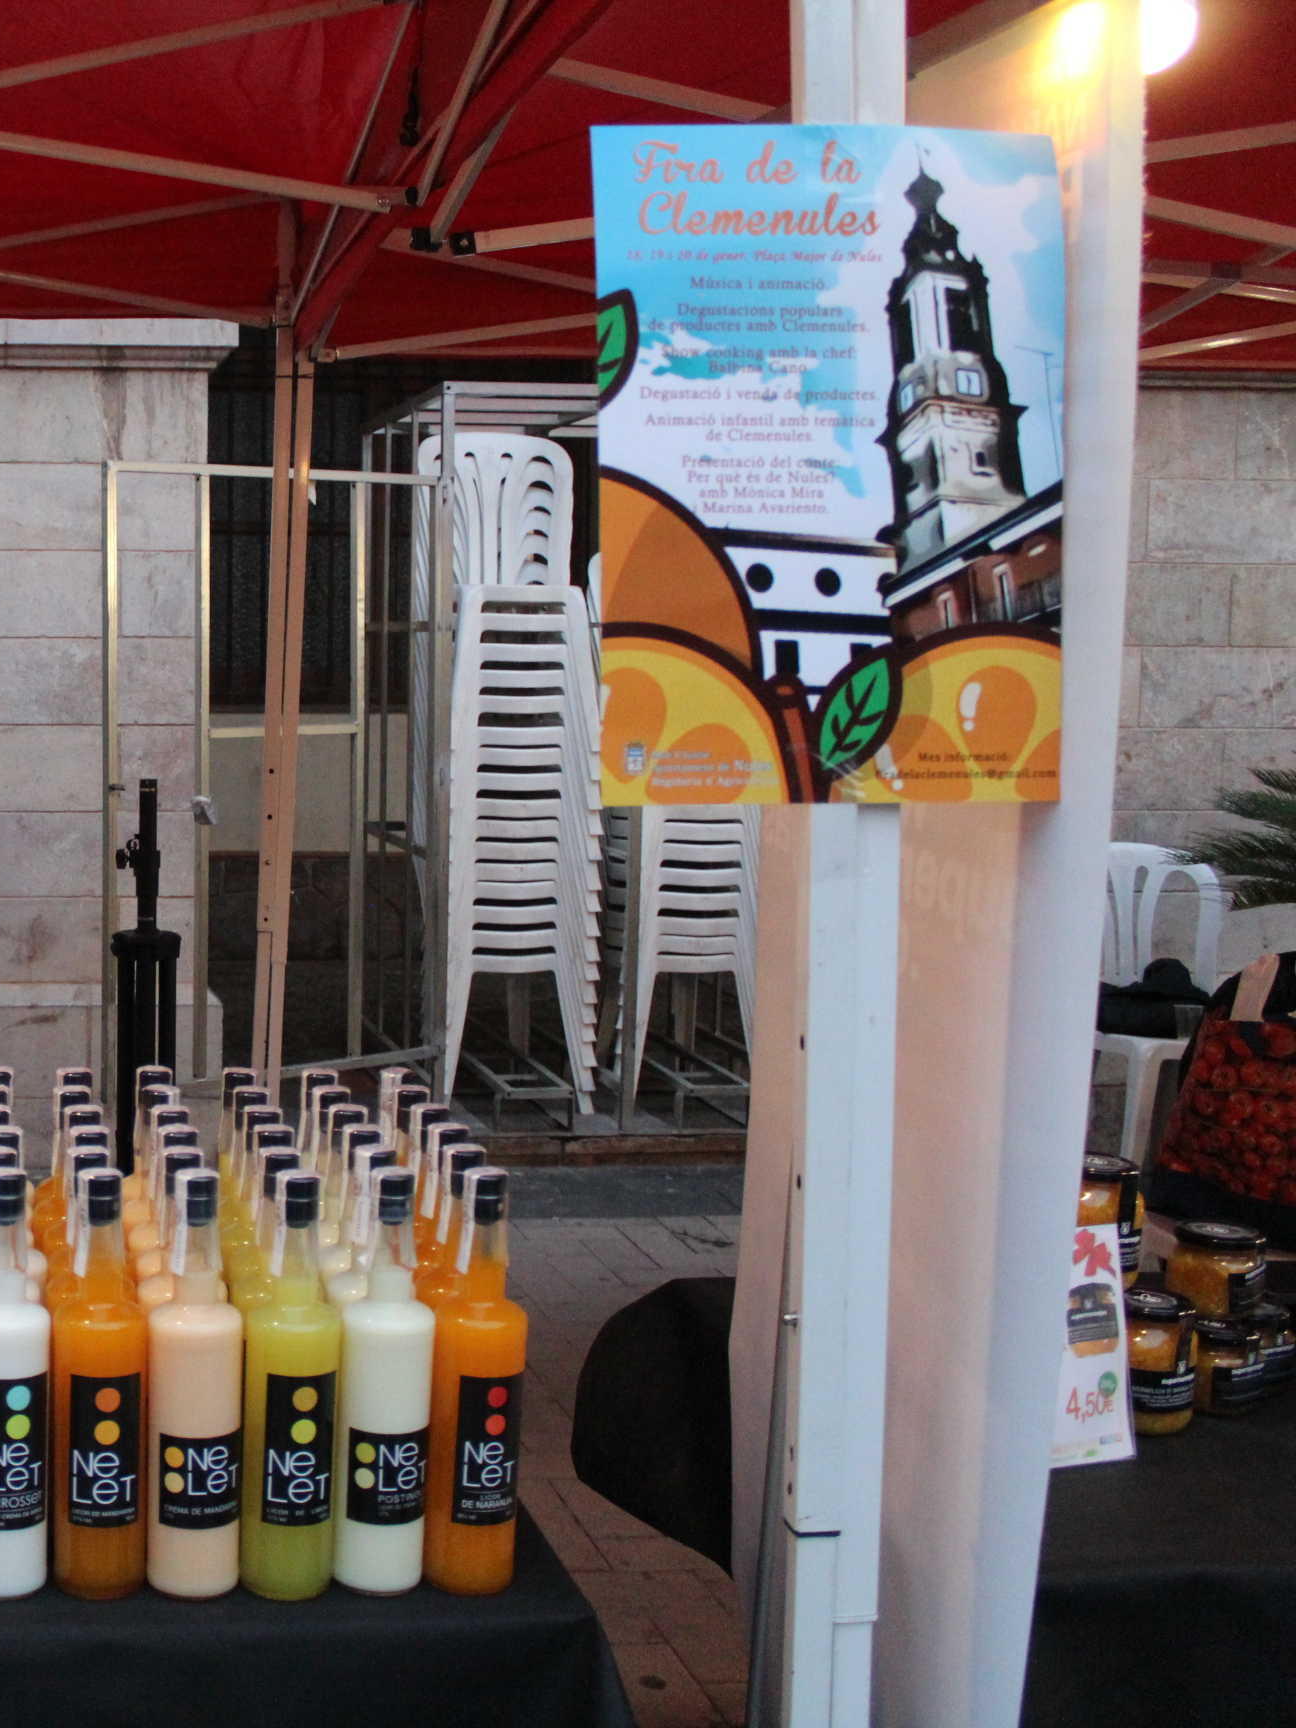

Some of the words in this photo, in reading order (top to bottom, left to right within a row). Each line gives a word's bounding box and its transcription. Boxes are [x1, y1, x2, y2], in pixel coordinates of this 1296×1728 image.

[632, 140, 724, 184] Fira
[746, 140, 797, 184] de
[819, 140, 861, 184] la
[638, 190, 881, 236] Clemenules
[696, 250, 709, 261] de
[792, 250, 827, 264] Major
[831, 250, 844, 261] de
[690, 276, 742, 290] Música
[677, 303, 776, 321] Degustacions
[780, 303, 843, 321] populars
[648, 318, 665, 331] de
[671, 319, 742, 335] productes
[746, 319, 776, 332] amb
[661, 344, 699, 359] Show
[705, 345, 765, 361] cooking
[769, 346, 800, 359] amb
[805, 345, 817, 358] la
[708, 360, 763, 373] Balbina
[639, 386, 721, 402] Degustació
[736, 387, 778, 401] venda
[784, 387, 801, 401] de
[645, 413, 716, 427] Animació
[720, 413, 774, 427] infantil
[779, 413, 809, 427] amb
[705, 429, 722, 442] de
[681, 455, 764, 468] Presentació
[769, 455, 792, 468] del
[687, 471, 710, 484] Per
[746, 471, 761, 484] és
[766, 471, 782, 484] de
[699, 486, 729, 499] amb
[790, 486, 825, 499] Mira
[702, 502, 753, 514] Marina
[462, 1499, 473, 1509] DE
